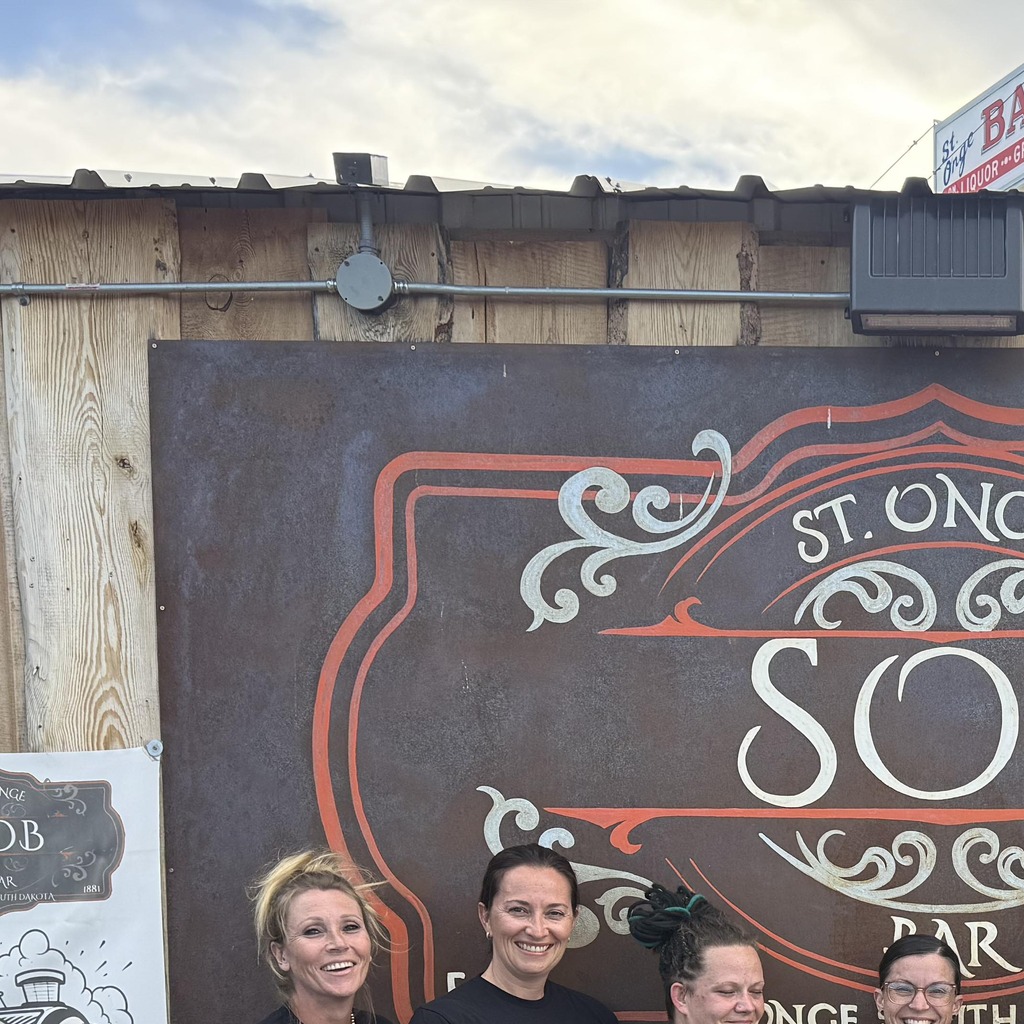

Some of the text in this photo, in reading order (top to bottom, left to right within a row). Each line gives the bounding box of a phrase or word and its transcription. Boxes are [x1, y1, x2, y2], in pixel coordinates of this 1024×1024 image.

[943, 131, 974, 186] Onge
[960, 160, 999, 193] LIQUOR
[792, 494, 873, 563] ST.
[0, 787, 25, 801] NGE
[0, 876, 18, 889] AR
[84, 885, 100, 893] 1881
[19, 892, 55, 902] DAKOTA
